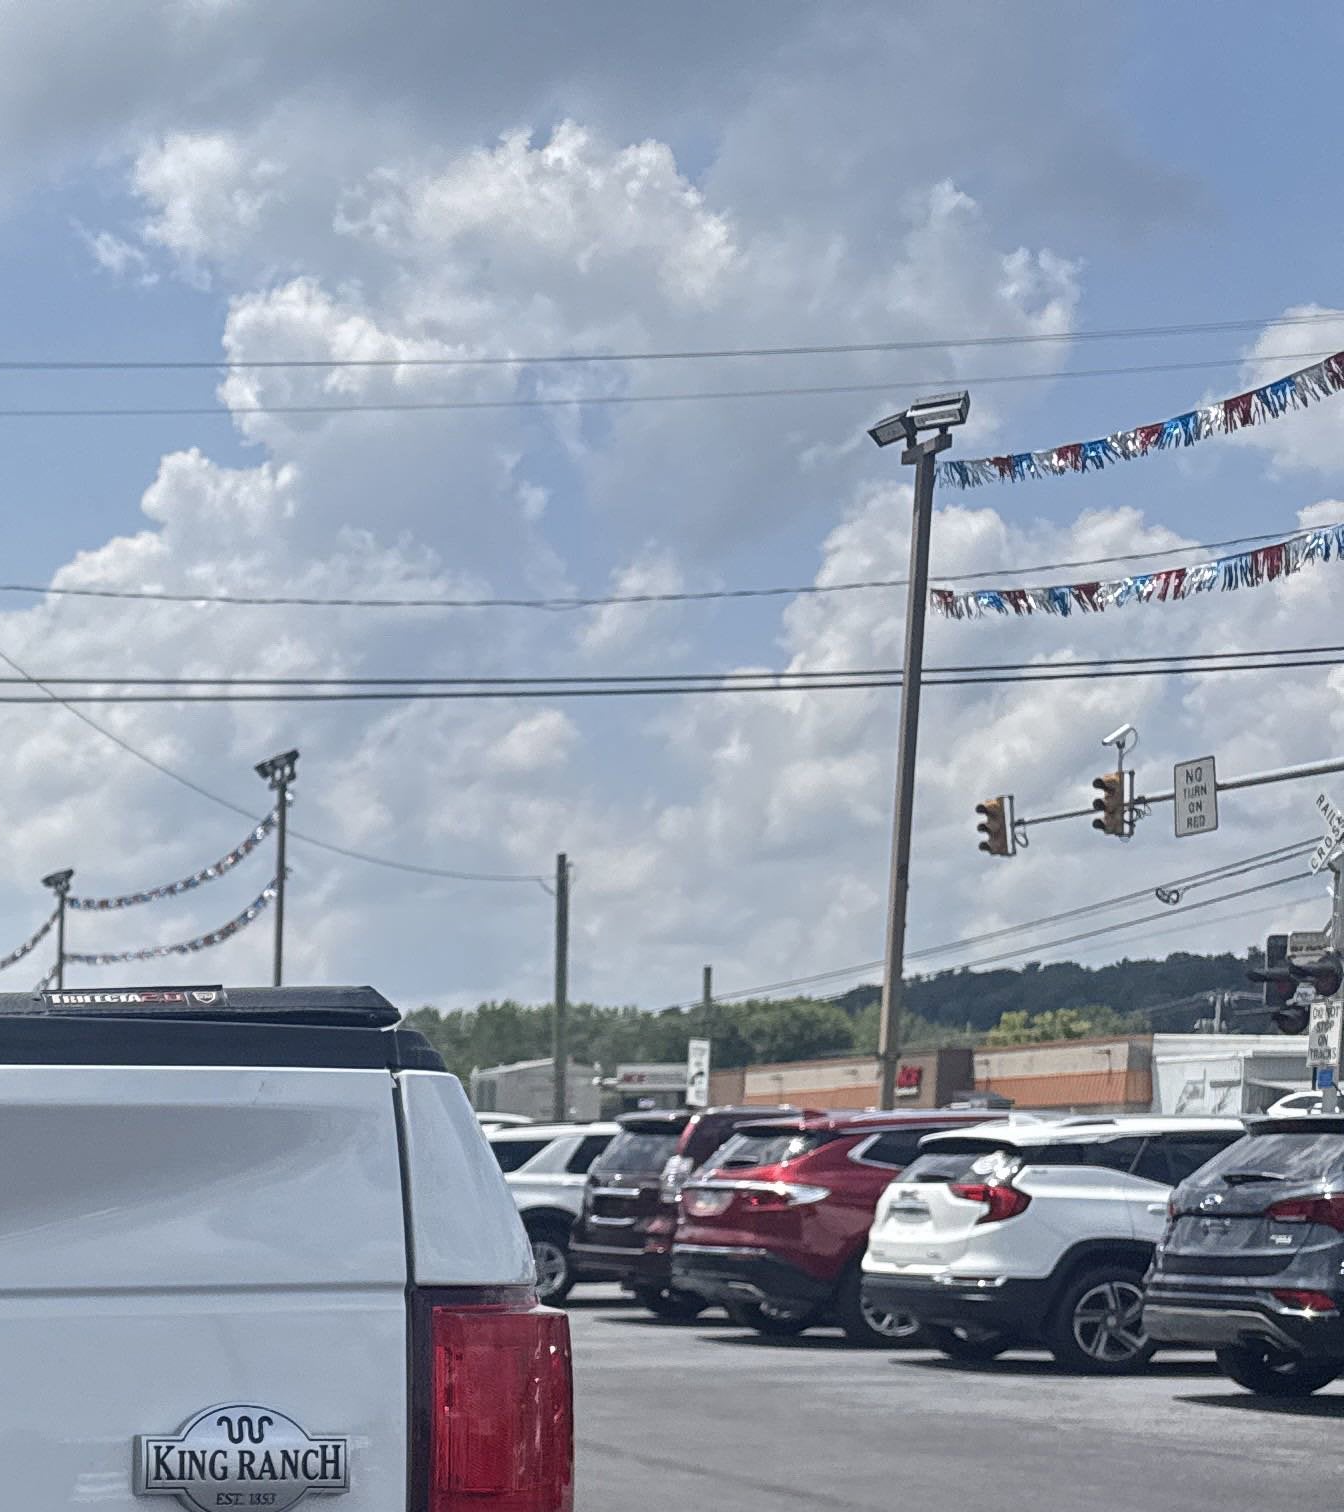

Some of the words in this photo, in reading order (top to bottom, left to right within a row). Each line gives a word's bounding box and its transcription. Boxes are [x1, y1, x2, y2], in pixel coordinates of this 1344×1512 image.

[1185, 766, 1203, 784] NO
[1183, 784, 1207, 800] TURN
[1188, 800, 1202, 814] ON
[1186, 815, 1205, 829] RED
[1312, 1007, 1324, 1020] DO
[1326, 1006, 1340, 1019] NOT
[1316, 1020, 1335, 1033] STOP
[1317, 1033, 1329, 1046] ON
[1310, 1047, 1337, 1060] TRACKS
[153, 1445, 228, 1481] KING
[236, 1444, 342, 1481] RANCH
